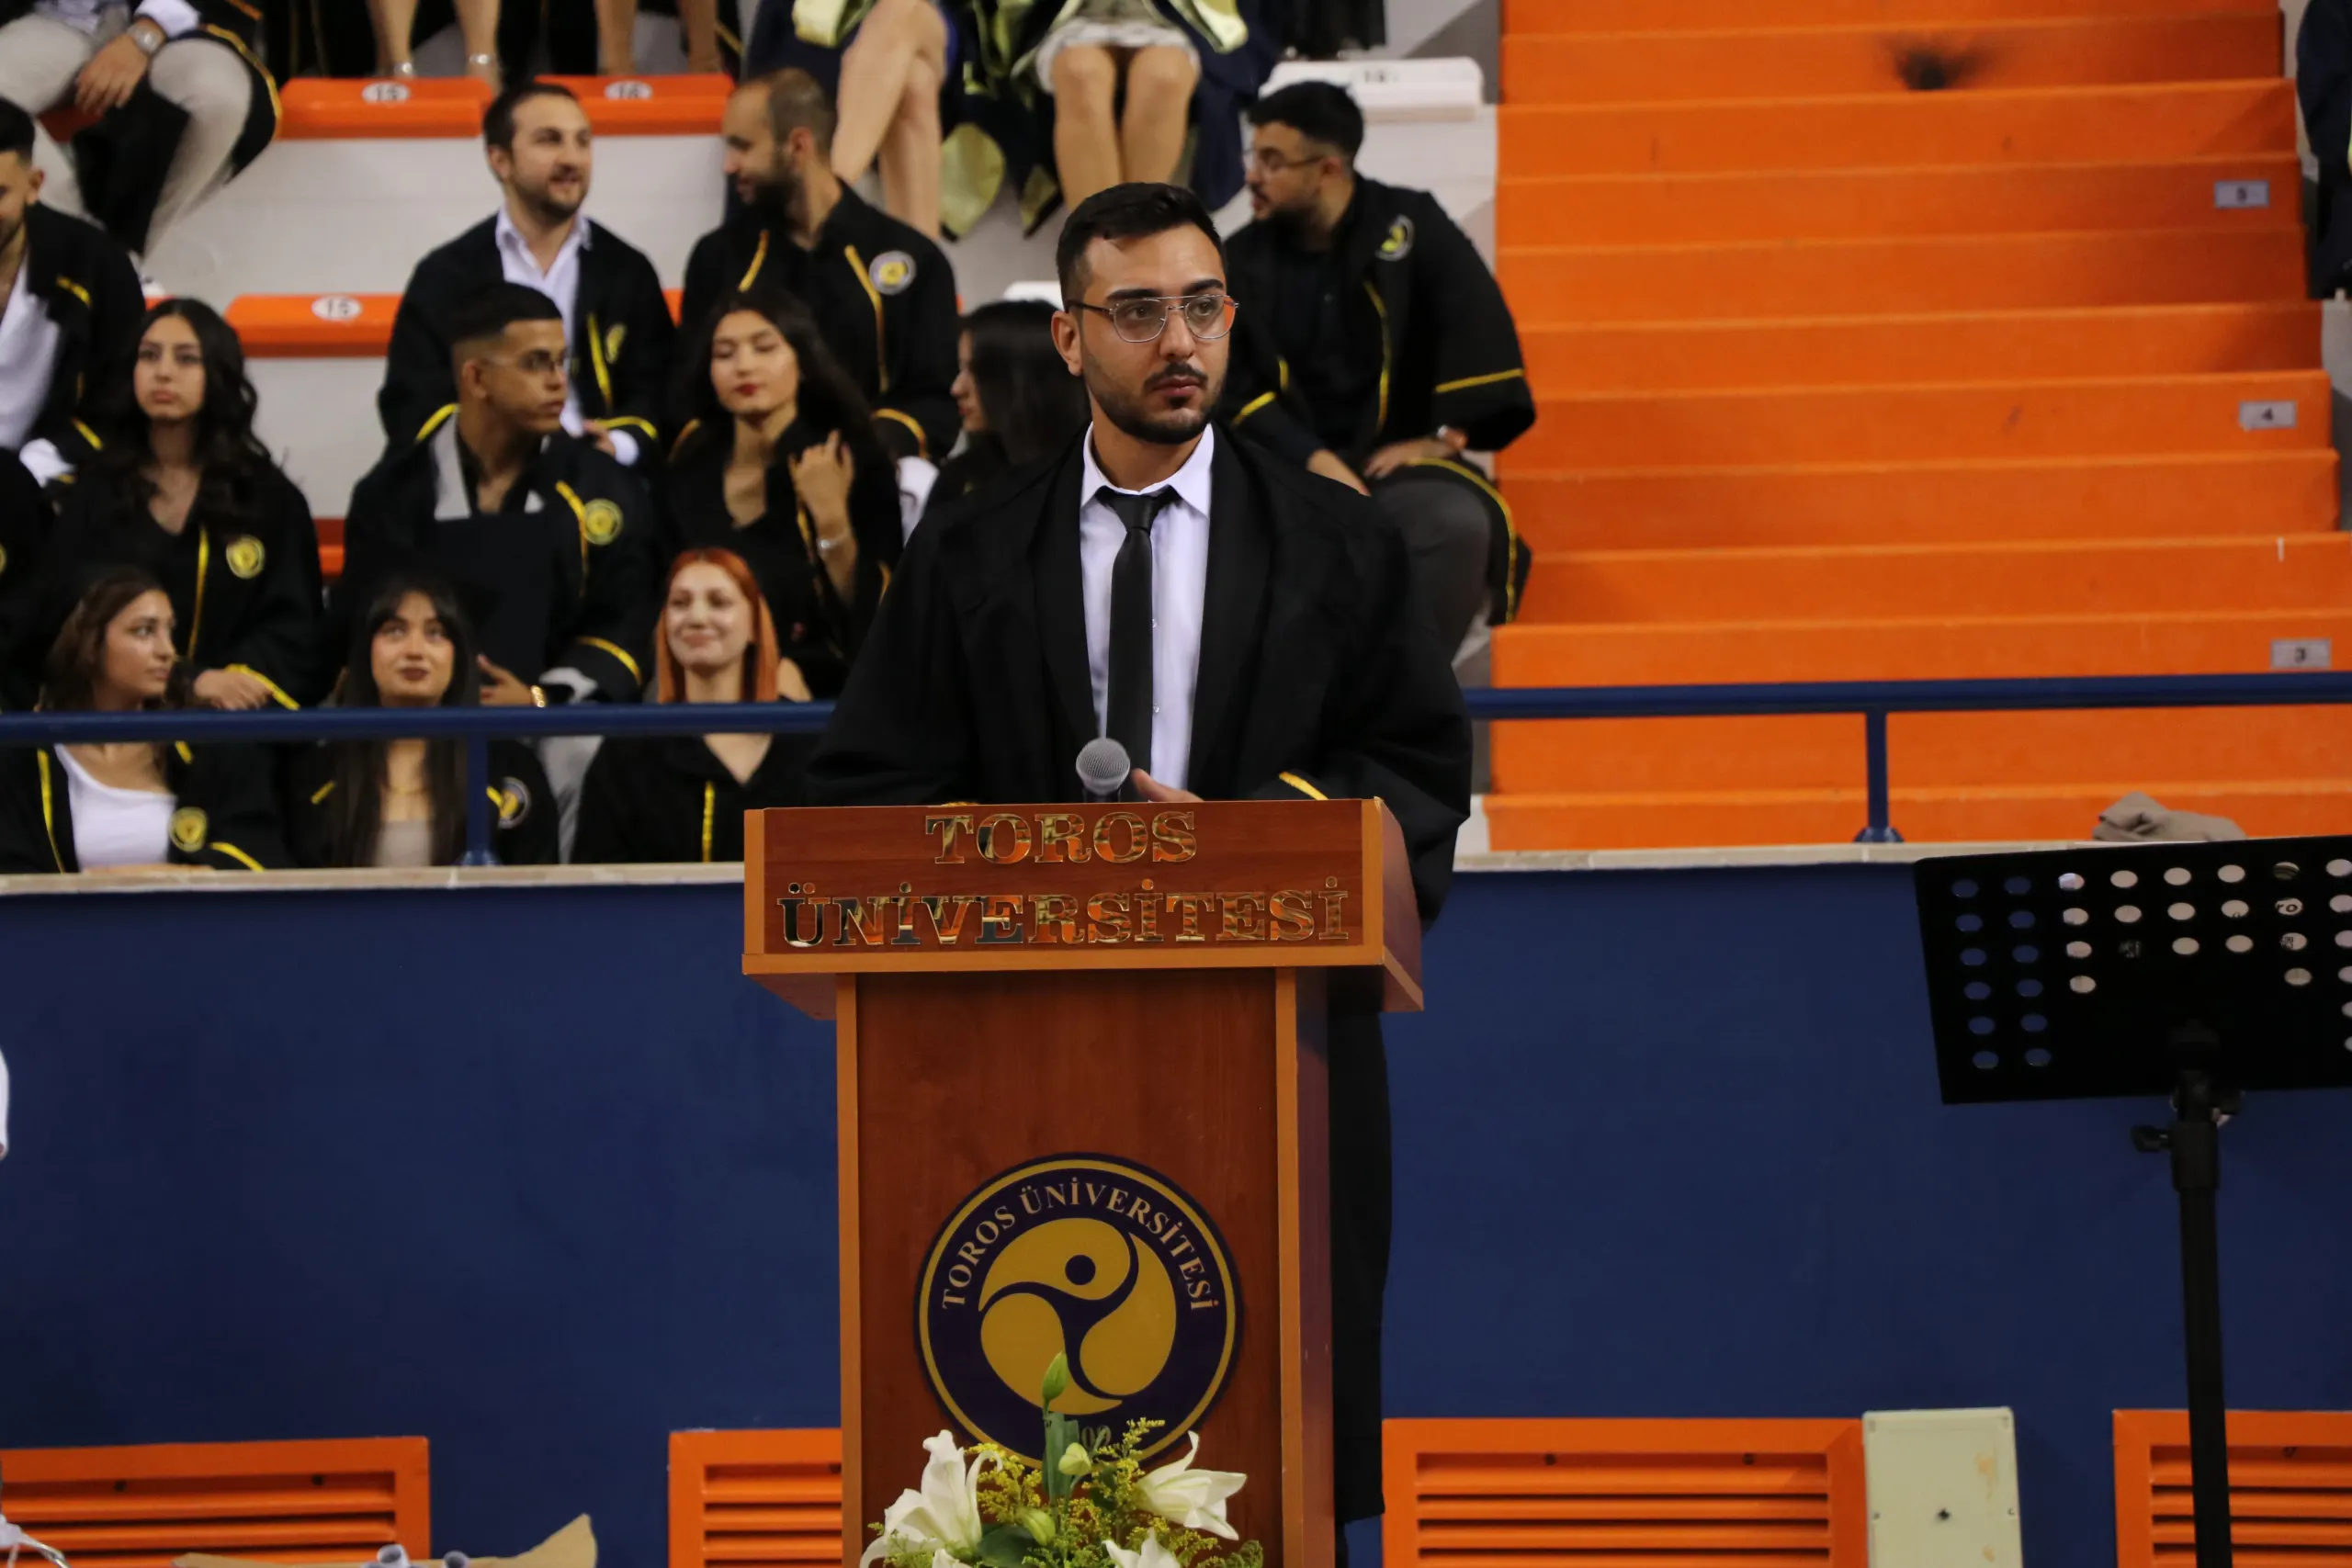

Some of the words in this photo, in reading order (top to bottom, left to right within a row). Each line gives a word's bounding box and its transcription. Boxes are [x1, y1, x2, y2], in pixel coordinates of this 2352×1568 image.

[925, 811, 1197, 863] TOROS
[777, 876, 1348, 947] ÜNİVERSİTESİ
[942, 1205, 1016, 1310] TOROS
[1019, 1177, 1220, 1311] ÜNİVERSİTESİ
